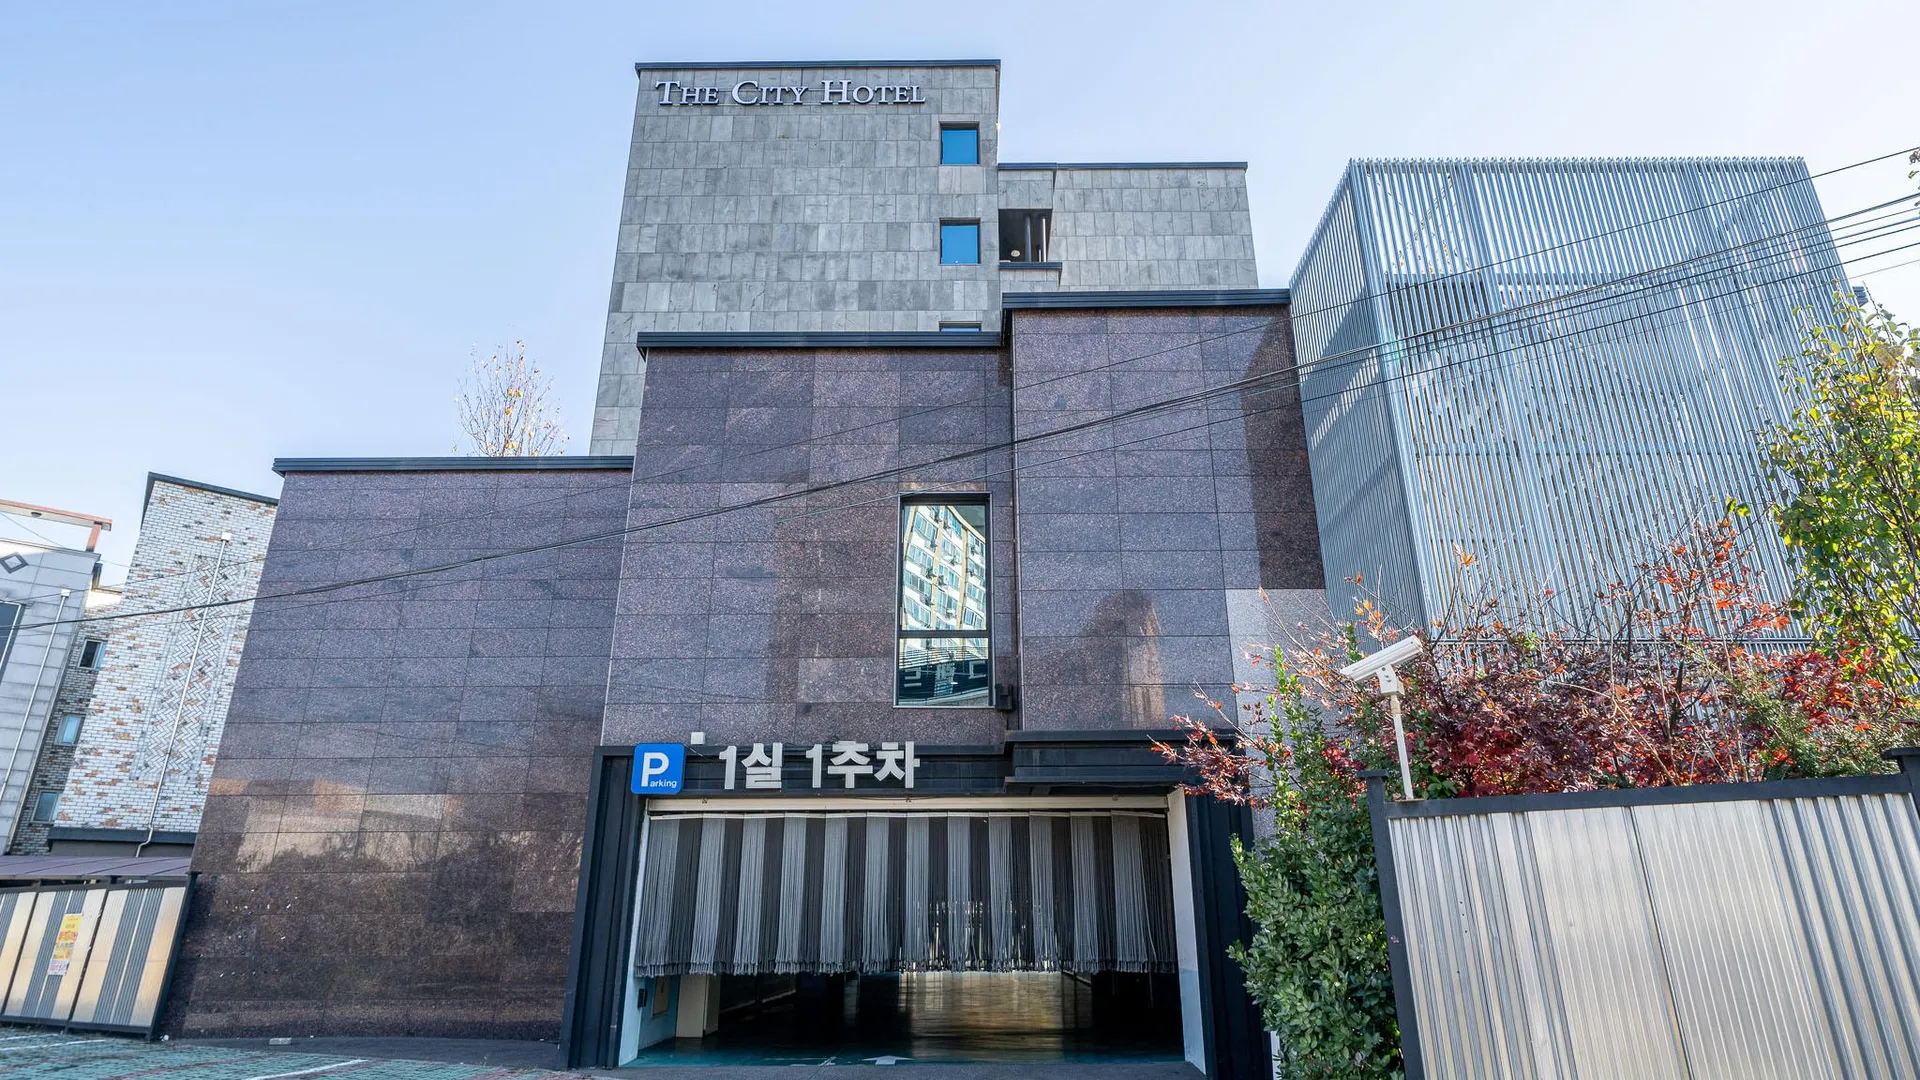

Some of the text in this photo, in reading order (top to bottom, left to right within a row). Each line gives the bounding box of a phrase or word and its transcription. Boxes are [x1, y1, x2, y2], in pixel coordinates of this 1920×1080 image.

[655, 79, 926, 105] THE CITY HOTEL
[719, 742, 783, 790] 1실
